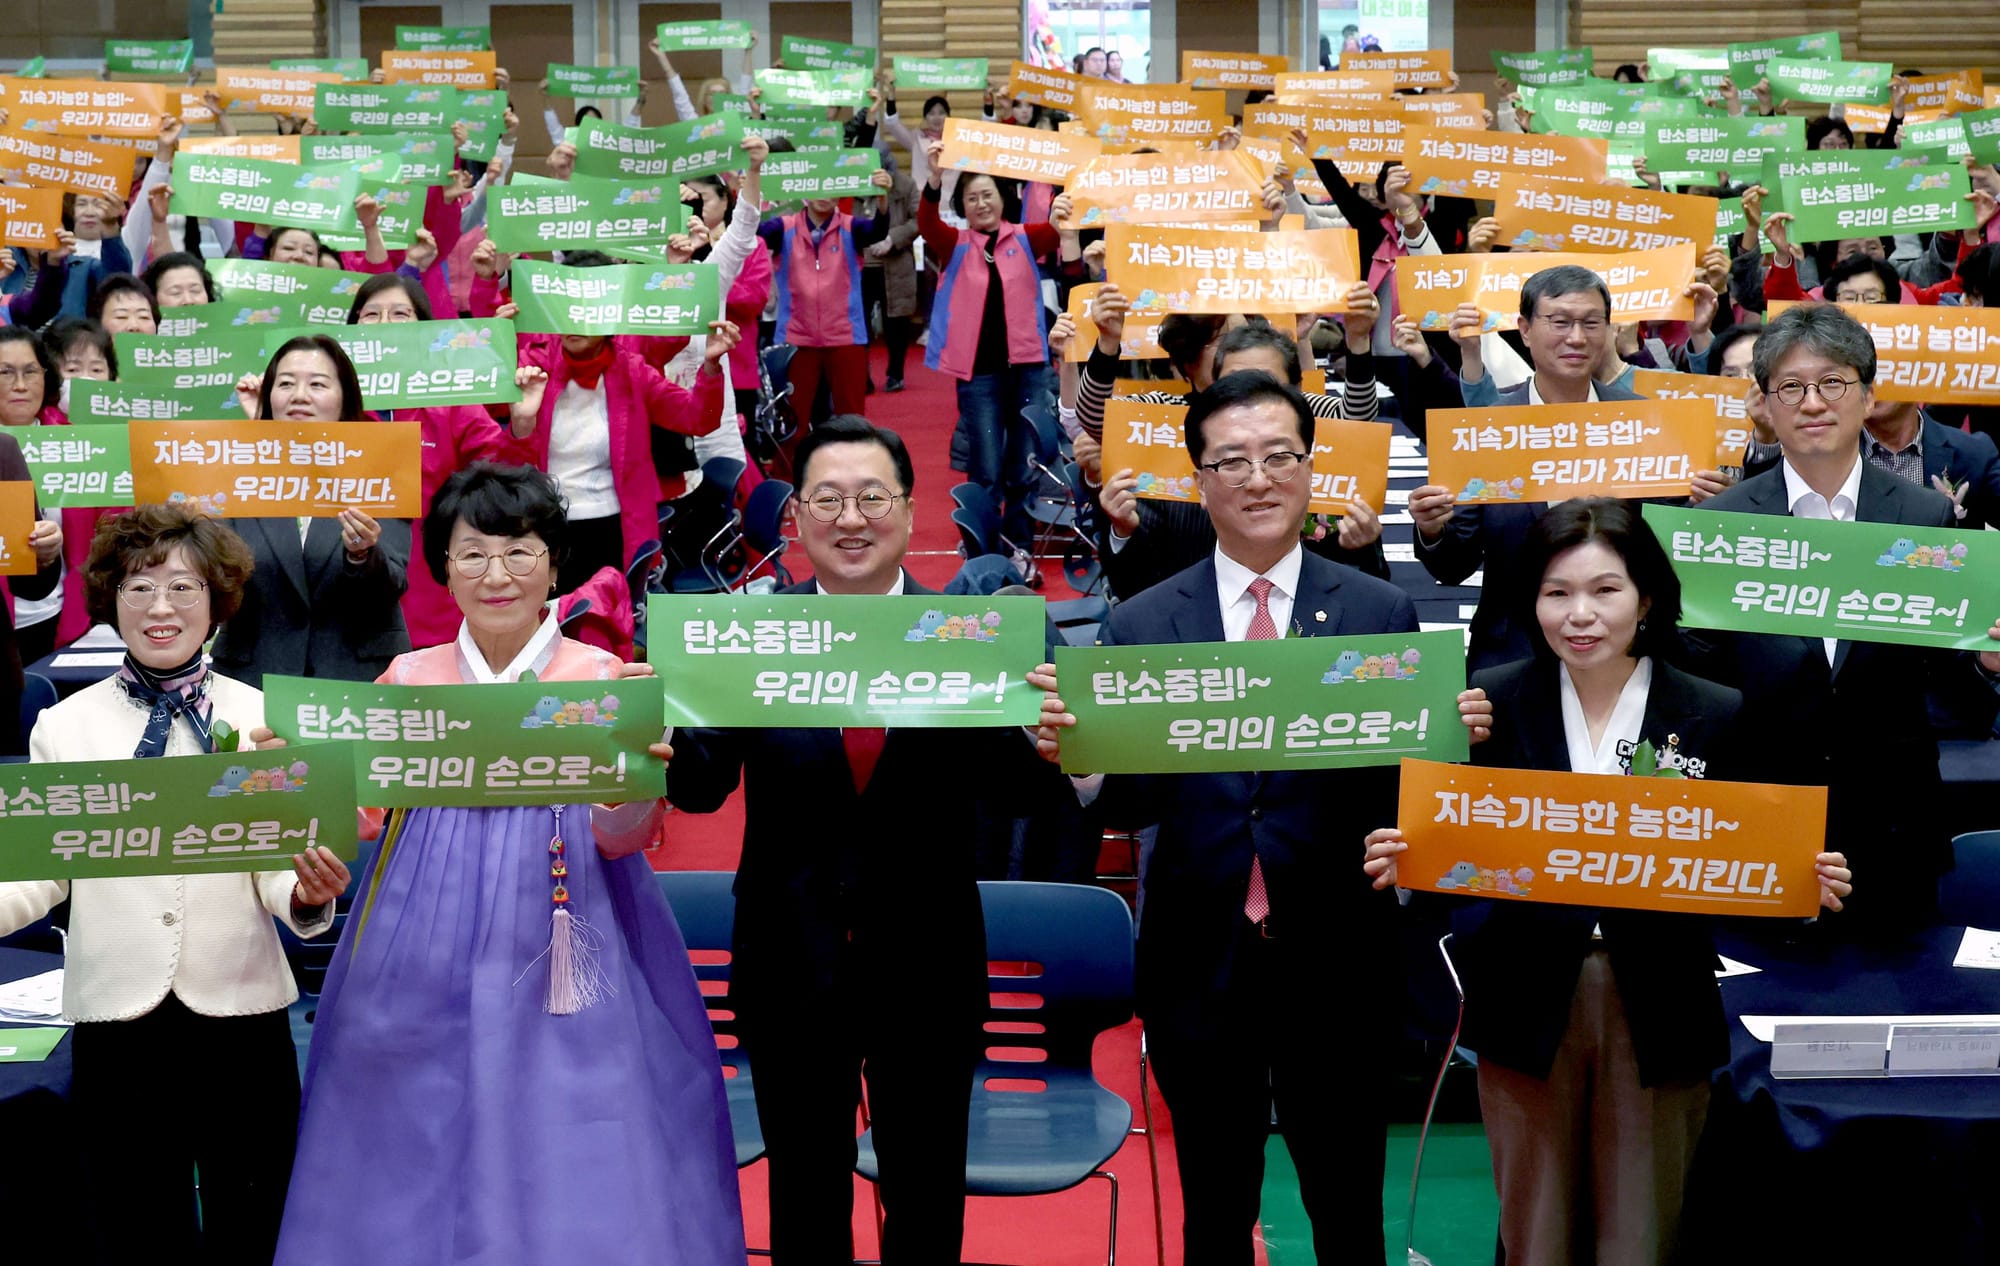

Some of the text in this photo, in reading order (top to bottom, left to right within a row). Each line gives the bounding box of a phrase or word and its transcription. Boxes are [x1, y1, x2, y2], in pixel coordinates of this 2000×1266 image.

[1778, 65, 1834, 80] 탄소중립!~
[19, 91, 134, 107] 지속가능한 농업!~
[325, 93, 388, 107] 탄소중립!~
[1798, 83, 1877, 98] 우리의 손으로~!
[1094, 95, 1198, 114] 지속가능한 농업!~
[1555, 99, 1614, 114] 탄소중립!~
[61, 112, 151, 128] 우리가 지킨다.
[351, 112, 443, 125] 우리의 손으로~!
[1131, 119, 1213, 133] 우리가 지킨다.
[1313, 118, 1370, 132] 지속가능한
[1576, 120, 1612, 132] 우리의
[589, 130, 666, 154] 탄소중립!~
[956, 129, 1070, 156] 지속가능한 농업!~
[1348, 138, 1384, 152] 우리가
[1658, 129, 1728, 143] 탄소중립!~
[60, 148, 103, 165] 농업!~
[313, 146, 381, 159] 탄소중립!~
[619, 147, 732, 174] 우리의 손으로~!
[995, 155, 1036, 172] 우리가
[1420, 141, 1508, 163] 지속가능한
[1513, 149, 1566, 166] 농업!~
[1686, 149, 1727, 163] 우리의
[26, 163, 118, 192] 우리가 지킨다.
[190, 166, 271, 187] 탄소중립!~
[781, 175, 873, 193] 우리의 손으로~!
[1077, 165, 1228, 188] 지속가능한 농업!~
[501, 196, 589, 216] 탄소중립!~
[1134, 191, 1253, 211] 우리가 지킨다.
[1515, 188, 1674, 224] 지속가능한 농업!~
[1802, 184, 1885, 205] 탄소중립!~
[218, 193, 341, 220] 우리의 손으로~!
[1838, 202, 1957, 228] 우리의 손으로~!
[537, 217, 666, 239] 우리의 손으로~!
[1569, 225, 1627, 247] 우리가
[1129, 243, 1309, 269] 지속가능한 농업!~
[221, 271, 308, 293] 탄소중립!~
[532, 274, 620, 299] 탄소중립!~
[1197, 279, 1263, 300] 우리가
[568, 305, 700, 325] 우리의 손으로~!
[134, 346, 232, 367] 탄소중립!~
[360, 368, 498, 395] 리의 손으로~!
[90, 395, 194, 419] 탄소중립!~
[1453, 421, 1660, 452] 지속가능한 농업!~
[22, 440, 106, 463] 소중립!~
[154, 439, 362, 466] 지속가능한 농업!~
[1531, 456, 1694, 486] 우리가 지킨다.
[42, 472, 107, 495] 우리의
[233, 477, 396, 502] 우리가 지킨다.
[1672, 530, 1831, 571] 탄소중립!~
[1732, 581, 1970, 627] 우리의 손으로~!
[684, 620, 856, 654] 탄소중립!~
[753, 671, 1007, 705] 우리의 손으로~!
[1093, 667, 1271, 706] 탄소중립!~
[297, 704, 471, 741] 탄소중립!~
[1167, 708, 1429, 752] 우리의 손으로~!
[368, 752, 626, 788] 우리의 손으로~!
[1434, 791, 1740, 841] 지속가능한 농업!~
[51, 818, 319, 861] 우리의 손으로~!
[1543, 848, 1784, 897] 우리가 지킨다.
